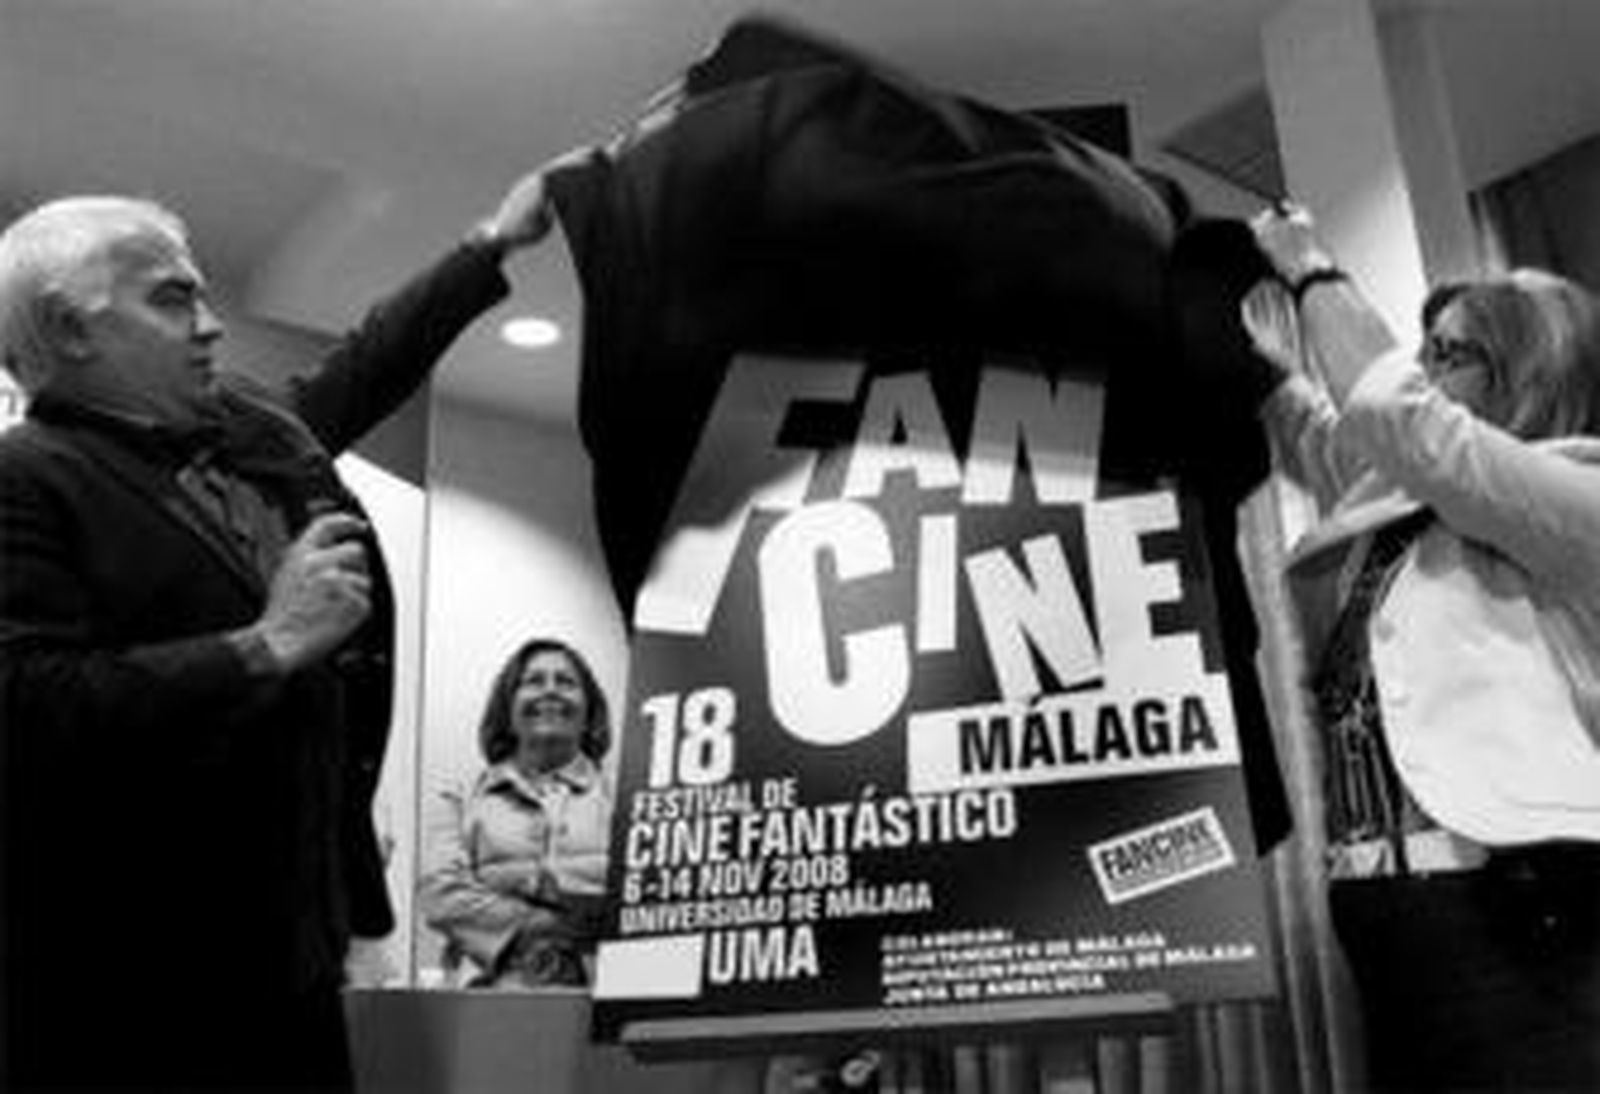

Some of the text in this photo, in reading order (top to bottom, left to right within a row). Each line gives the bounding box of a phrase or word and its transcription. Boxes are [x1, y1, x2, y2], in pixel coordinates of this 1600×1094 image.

[633, 354, 1106, 635] FAN
[757, 491, 1222, 745] CINE
[641, 686, 737, 790] 18
[957, 690, 1218, 775] MÁLAGA
[625, 783, 1018, 870] CINE FANTÁSTICO
[629, 777, 798, 820] FESTIVAL DE
[619, 897, 785, 934] UNIVERSIDAD
[788, 891, 820, 921] DE
[697, 855, 765, 897] NOV
[768, 853, 849, 892] 2008
[707, 924, 820, 984] UMA
